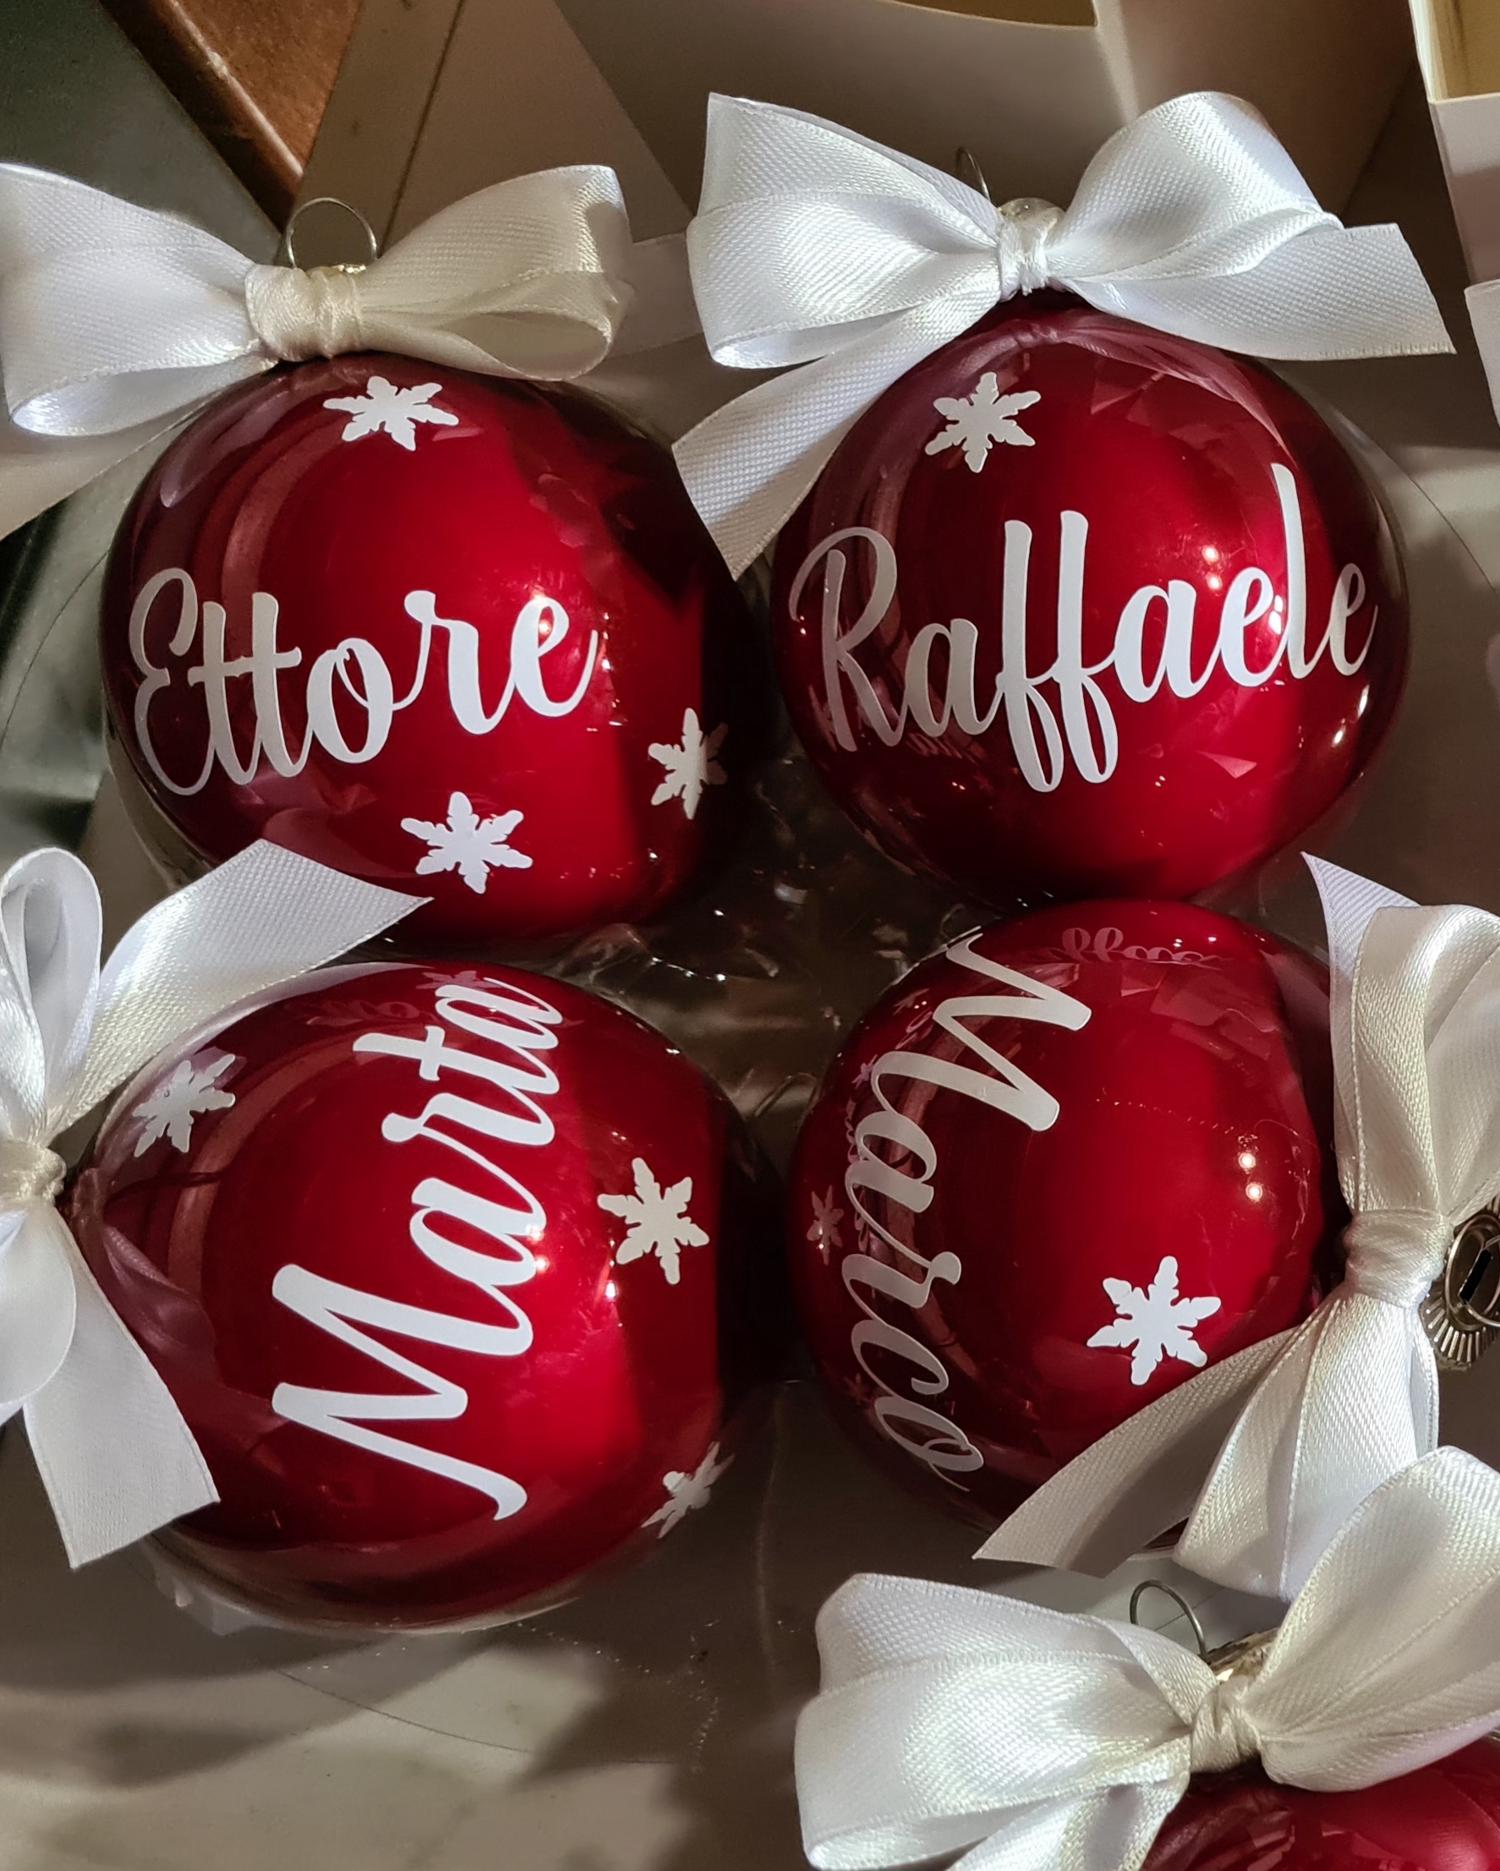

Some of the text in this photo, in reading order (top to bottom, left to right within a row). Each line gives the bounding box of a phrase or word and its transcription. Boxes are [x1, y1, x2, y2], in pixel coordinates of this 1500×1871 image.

[129, 568, 598, 796] Ettore
[788, 464, 1378, 793] Raffaele
[272, 976, 564, 1521] Marta
[841, 927, 1092, 1493] Marco
